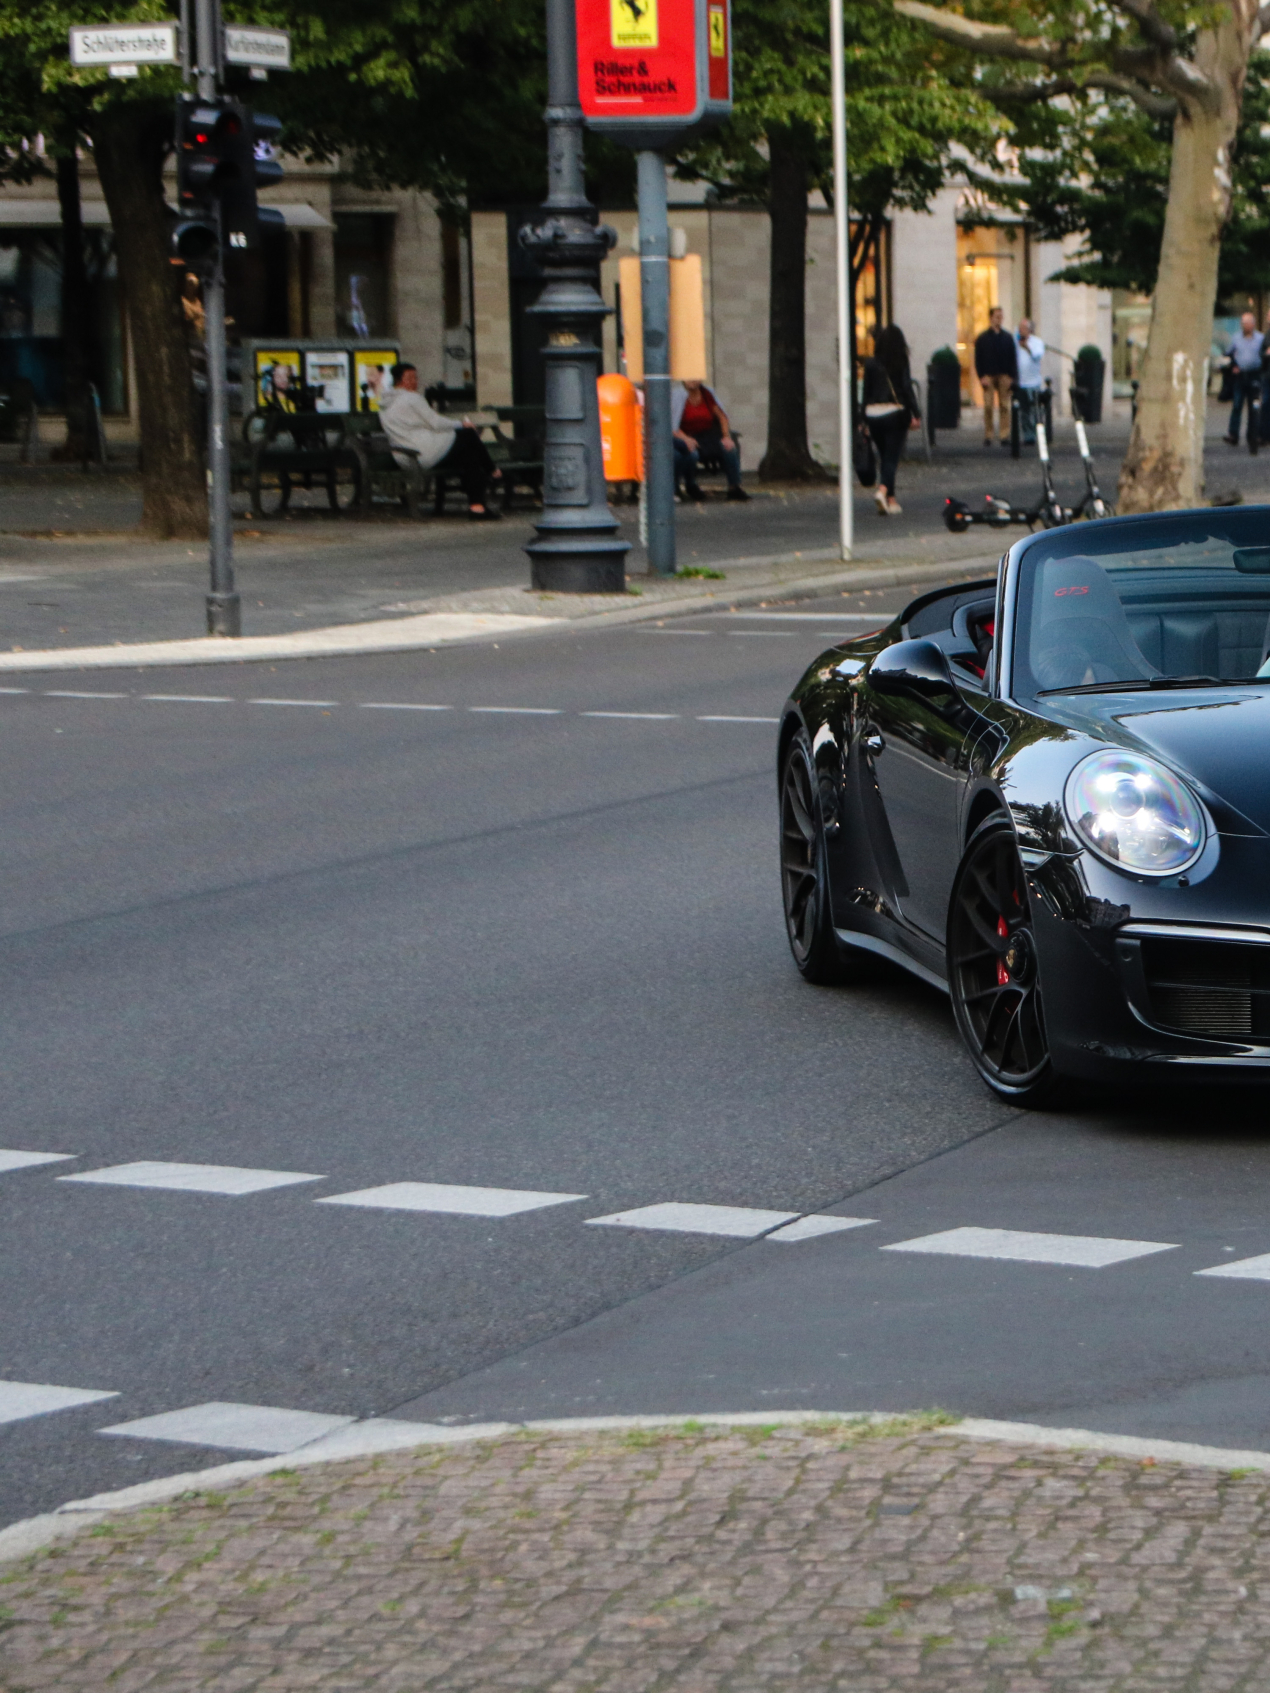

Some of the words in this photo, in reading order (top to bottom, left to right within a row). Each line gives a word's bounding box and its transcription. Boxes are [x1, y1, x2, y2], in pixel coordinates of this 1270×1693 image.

[81, 33, 167, 55] Schlüterstraße
[594, 60, 633, 76] Riller
[637, 60, 649, 77] &
[595, 77, 678, 94] Schnauck
[1054, 586, 1089, 597] GTS
